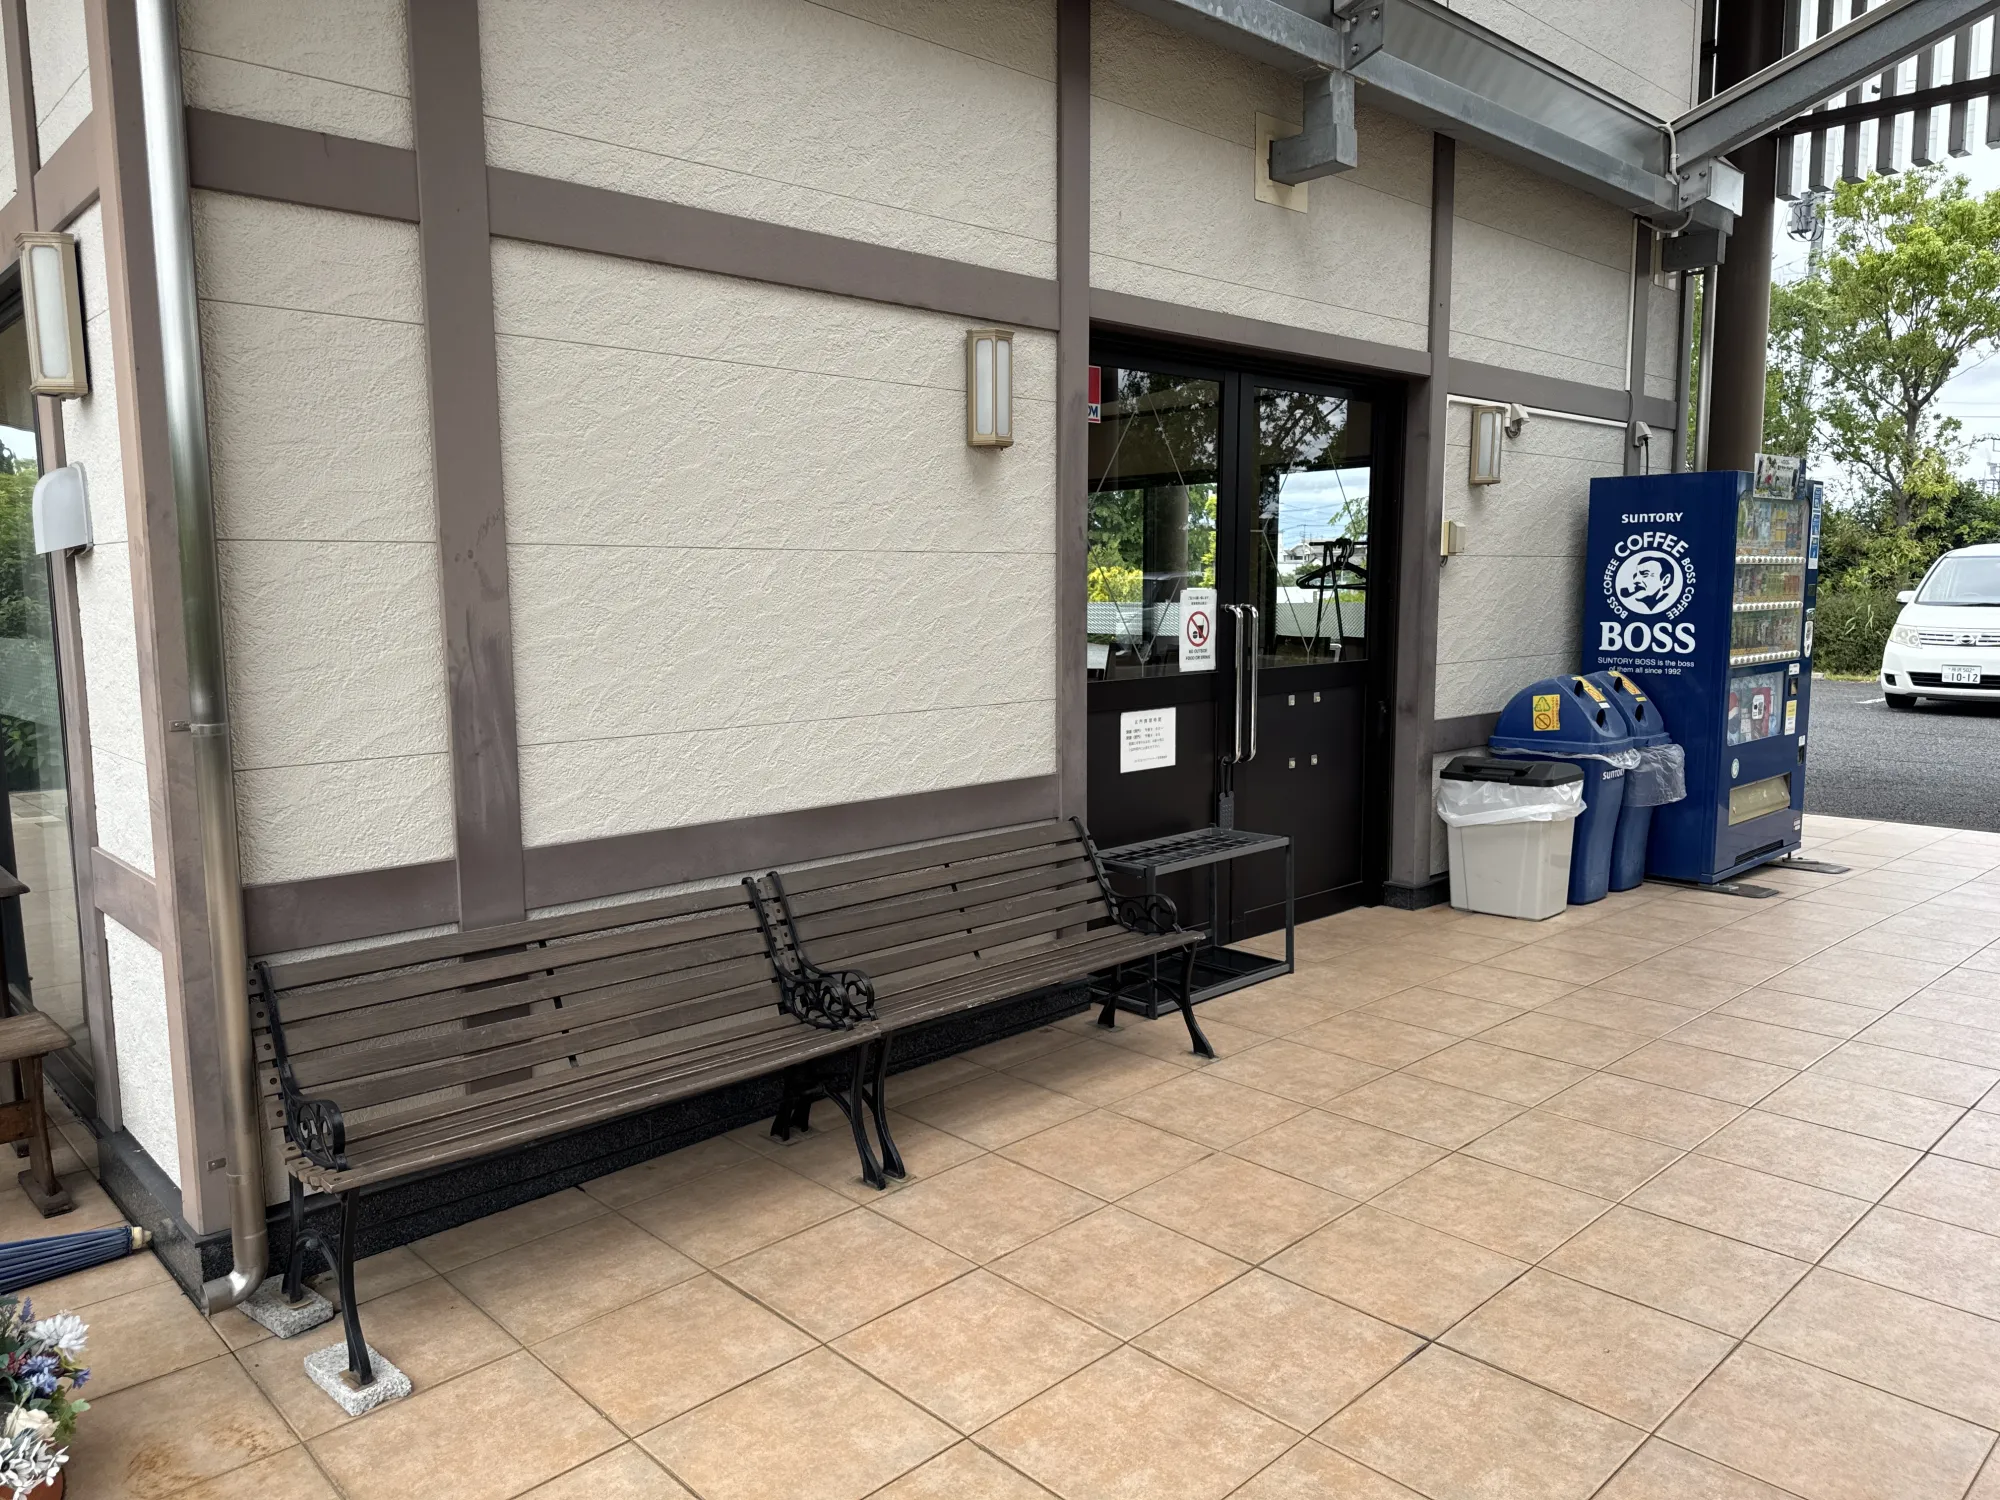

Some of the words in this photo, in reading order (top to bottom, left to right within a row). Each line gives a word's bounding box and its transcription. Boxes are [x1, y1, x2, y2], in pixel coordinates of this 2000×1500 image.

[1621, 512, 1683, 524] SUNTORY
[1614, 531, 1689, 558] COFFEE
[1603, 558, 1620, 595] COFFEE
[1681, 557, 1696, 584] BOSS
[1606, 596, 1628, 620] BOSS
[1665, 586, 1695, 620] COFFEE
[1598, 621, 1696, 654] BOSS
[1597, 656, 1633, 665] SUNTORY
[1635, 658, 1656, 666] BOSS
[1951, 673, 1978, 682] 10-12
